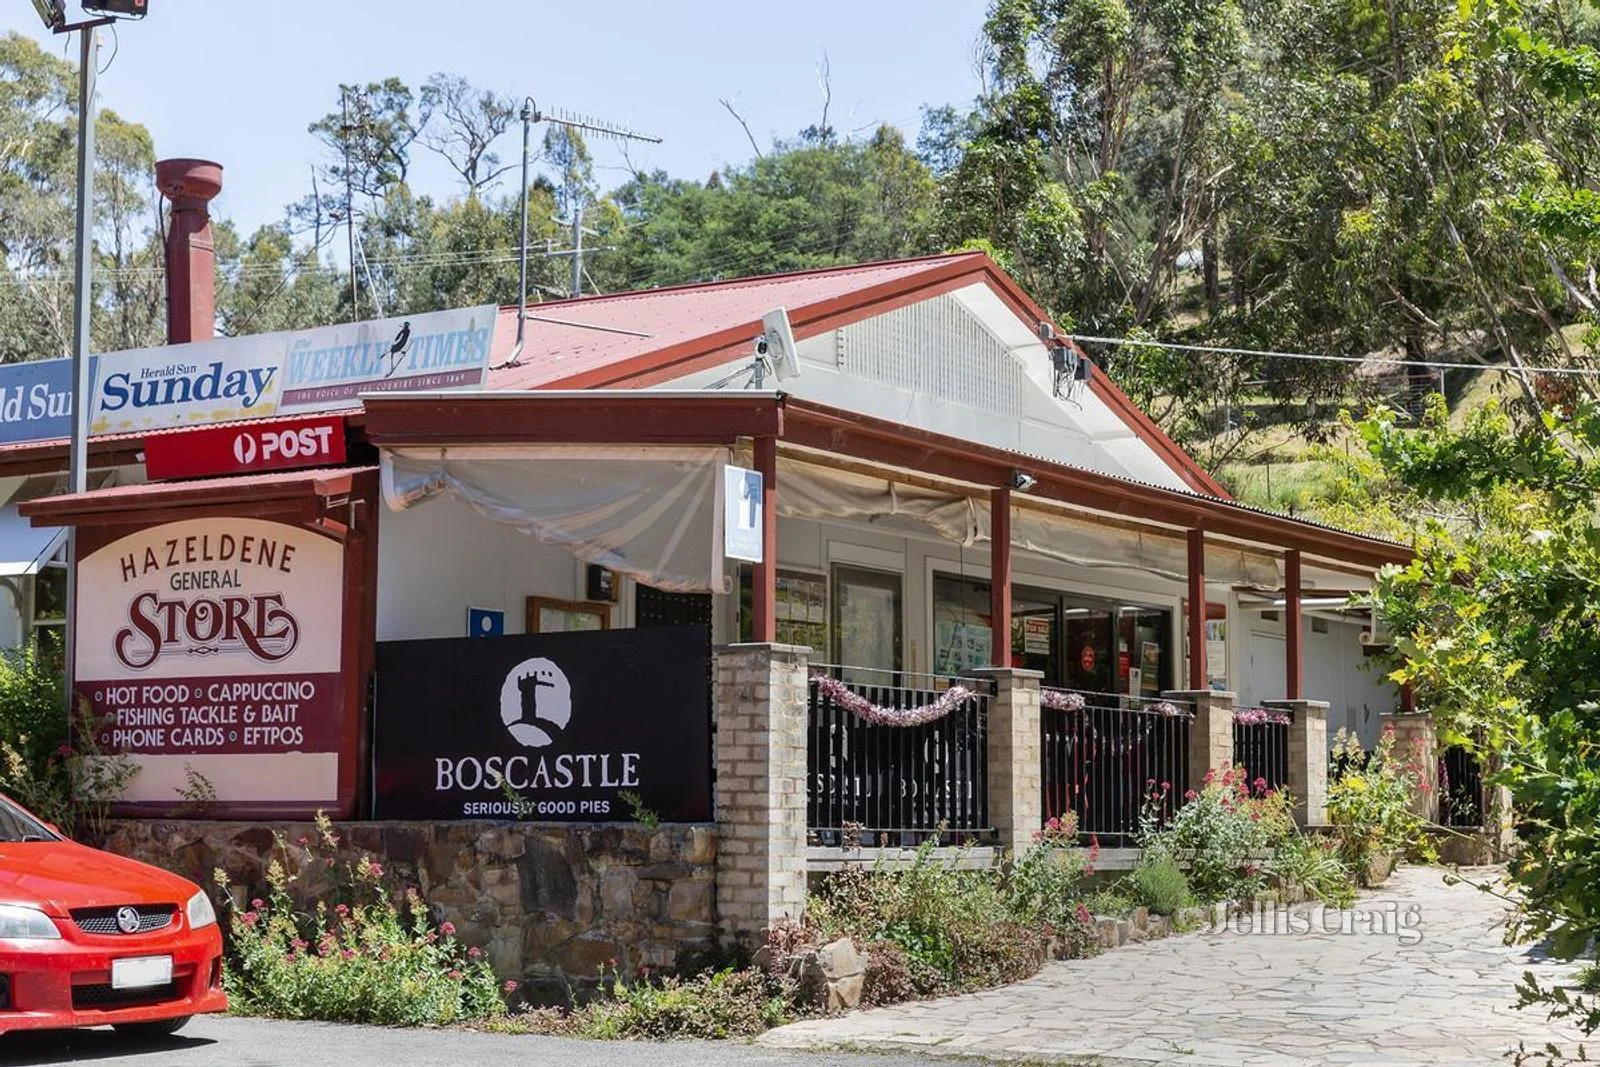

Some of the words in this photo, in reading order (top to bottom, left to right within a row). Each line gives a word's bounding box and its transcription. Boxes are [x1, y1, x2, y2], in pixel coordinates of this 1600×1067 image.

[288, 340, 391, 385] WEEKLY
[408, 326, 489, 370] TIMES
[141, 365, 175, 379] Herald
[177, 363, 197, 376] Sun
[100, 361, 278, 412] Sunday
[261, 425, 333, 460] POST
[120, 533, 296, 583] HAZELDENE
[170, 569, 242, 591] GENERAL
[115, 592, 299, 668] STORE
[106, 687, 137, 705] HOT
[142, 684, 190, 704] FOOD
[208, 680, 315, 702] CAPPUCCINO
[117, 707, 174, 726] FISHING
[180, 705, 238, 724] TACKLE
[243, 704, 256, 723] &
[261, 703, 298, 722] BAIT
[113, 728, 165, 747] PHONE
[170, 727, 224, 746] CARDS
[243, 726, 303, 745] EFTPOS
[435, 753, 640, 791] BOSCASTLE
[538, 801, 576, 813] GOOD
[580, 800, 610, 813] PIES
